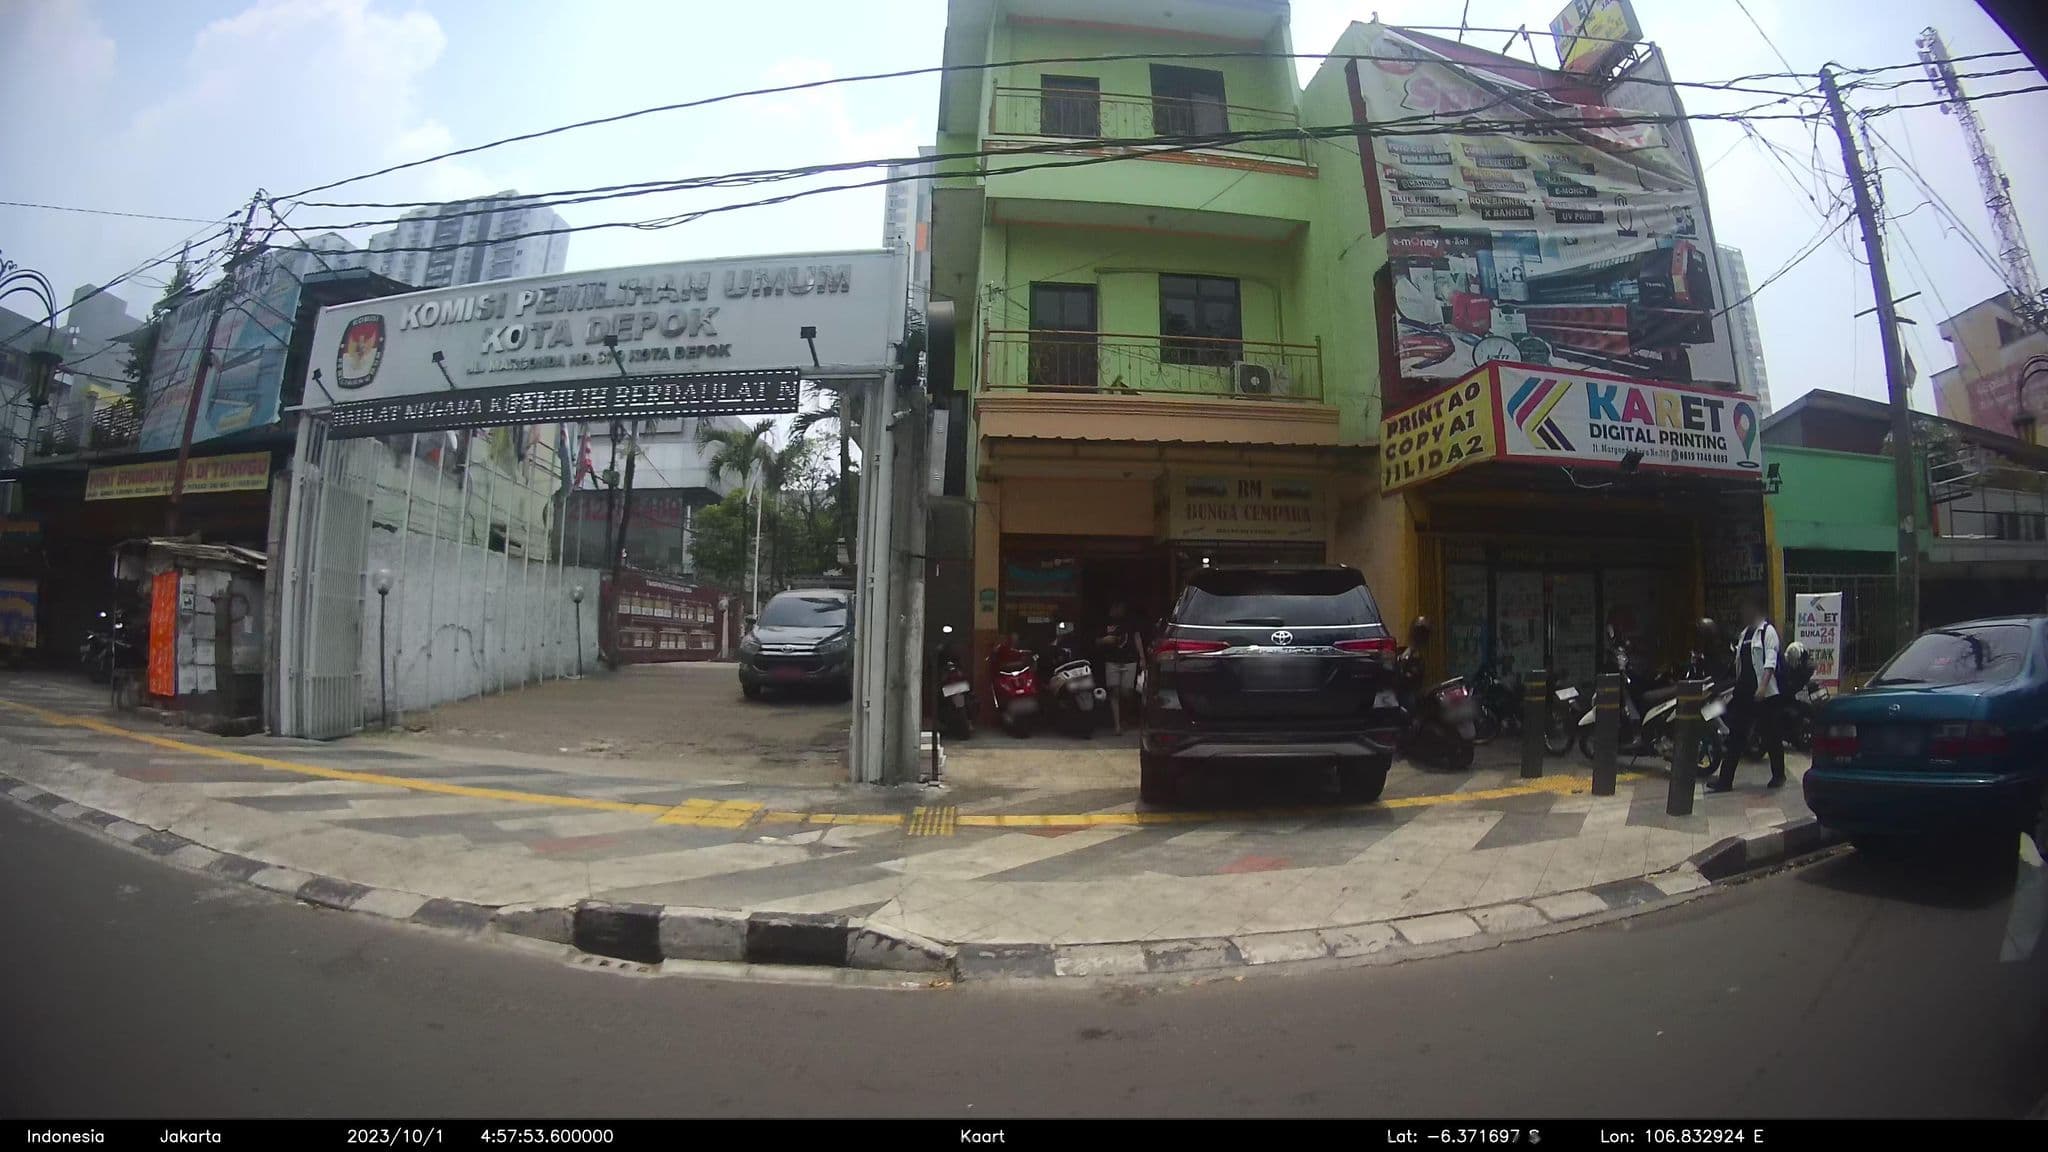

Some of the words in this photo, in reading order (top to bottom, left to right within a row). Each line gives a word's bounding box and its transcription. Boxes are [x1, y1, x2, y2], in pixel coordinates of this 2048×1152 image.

[1493, 208, 1530, 218] BANNER
[400, 292, 508, 331] KOMISI
[515, 271, 711, 316] PEMILIHAN
[724, 264, 852, 298] UMUM
[481, 319, 573, 355] KOTA
[585, 306, 720, 346] DEPOK
[629, 346, 671, 363] KOTA
[674, 343, 733, 361] DEPOK
[613, 381, 772, 407] BERDAULAT
[1585, 381, 1725, 434] KARET
[1385, 422, 1445, 460] COPY
[1449, 409, 1475, 437] A1
[1386, 398, 1445, 440] PRINT
[1589, 422, 1657, 444] DIGITAL
[1659, 430, 1728, 451] PRINTING
[1385, 449, 1443, 487] JILID
[1446, 435, 1484, 464] A2
[1798, 612, 1838, 623] KAET
[1820, 627, 1836, 638] 24
